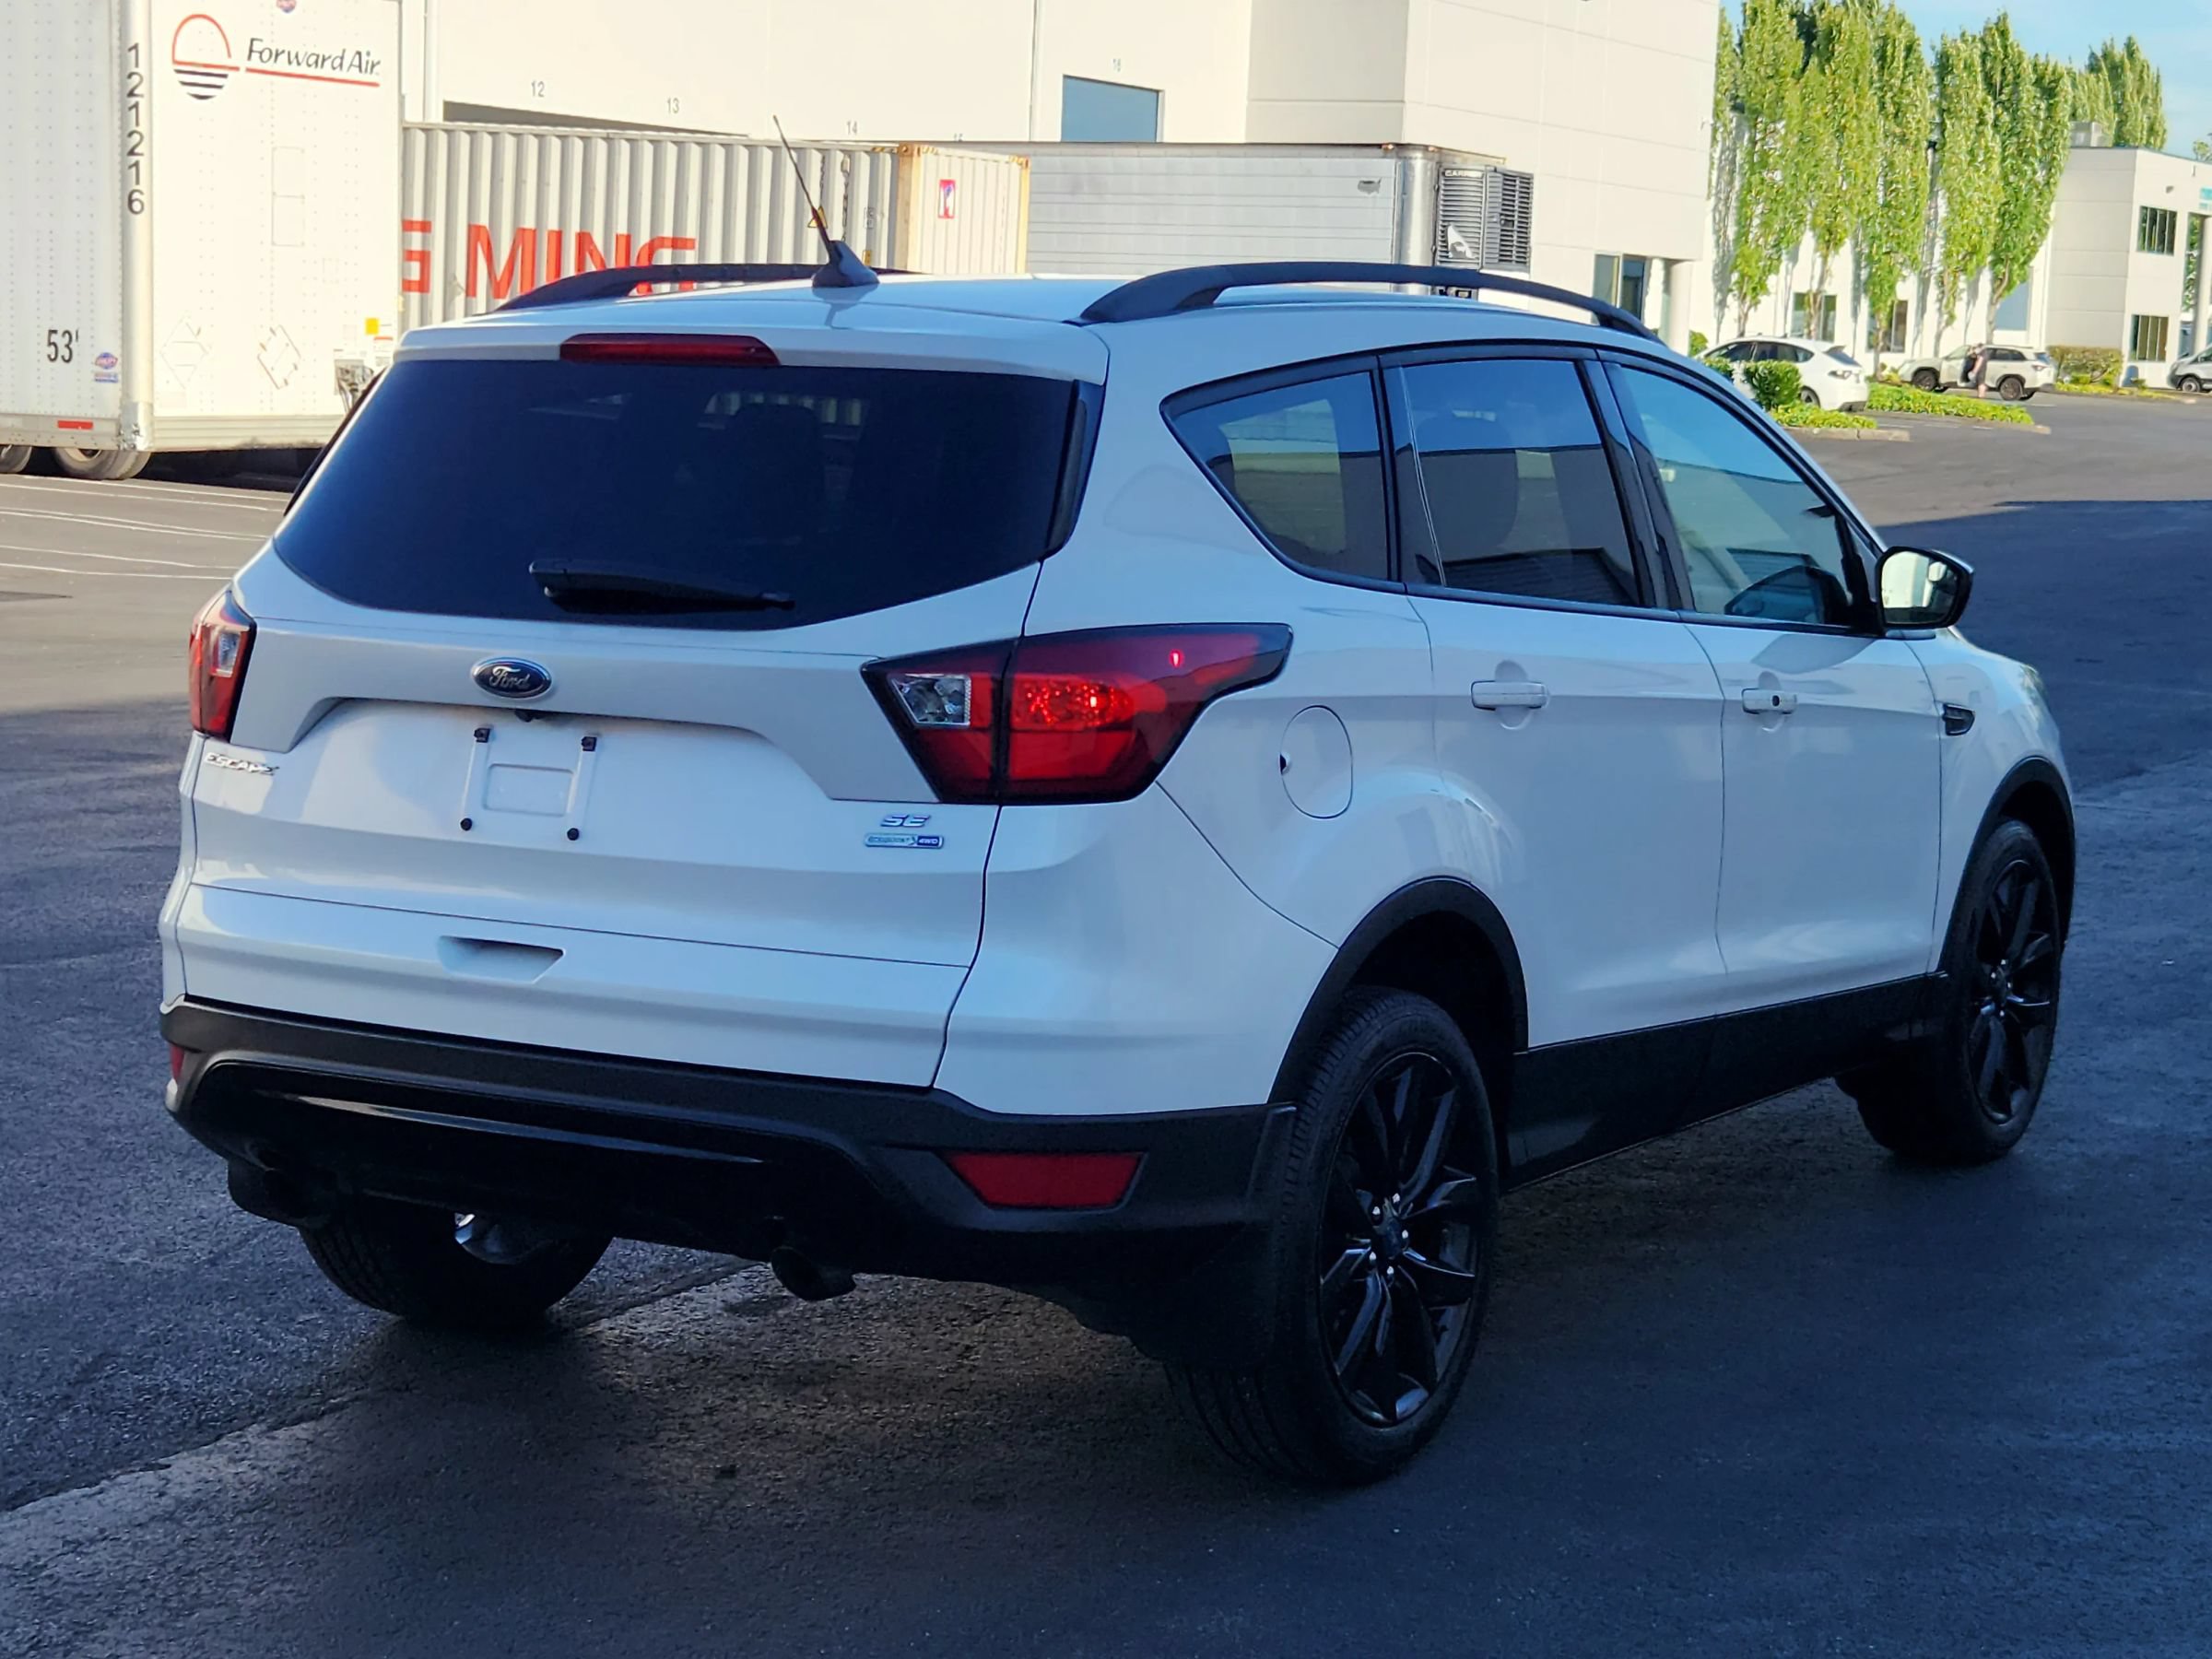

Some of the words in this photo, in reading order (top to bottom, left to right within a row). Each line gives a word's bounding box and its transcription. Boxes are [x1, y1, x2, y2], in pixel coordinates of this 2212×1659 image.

[247, 37, 346, 72] Forward
[347, 50, 382, 75] Air
[531, 80, 545, 98] 12
[666, 97, 679, 114] 13
[126, 42, 145, 215] 121216
[847, 121, 857, 135] 14
[489, 665, 531, 689] Ford
[880, 814, 931, 828] SE
